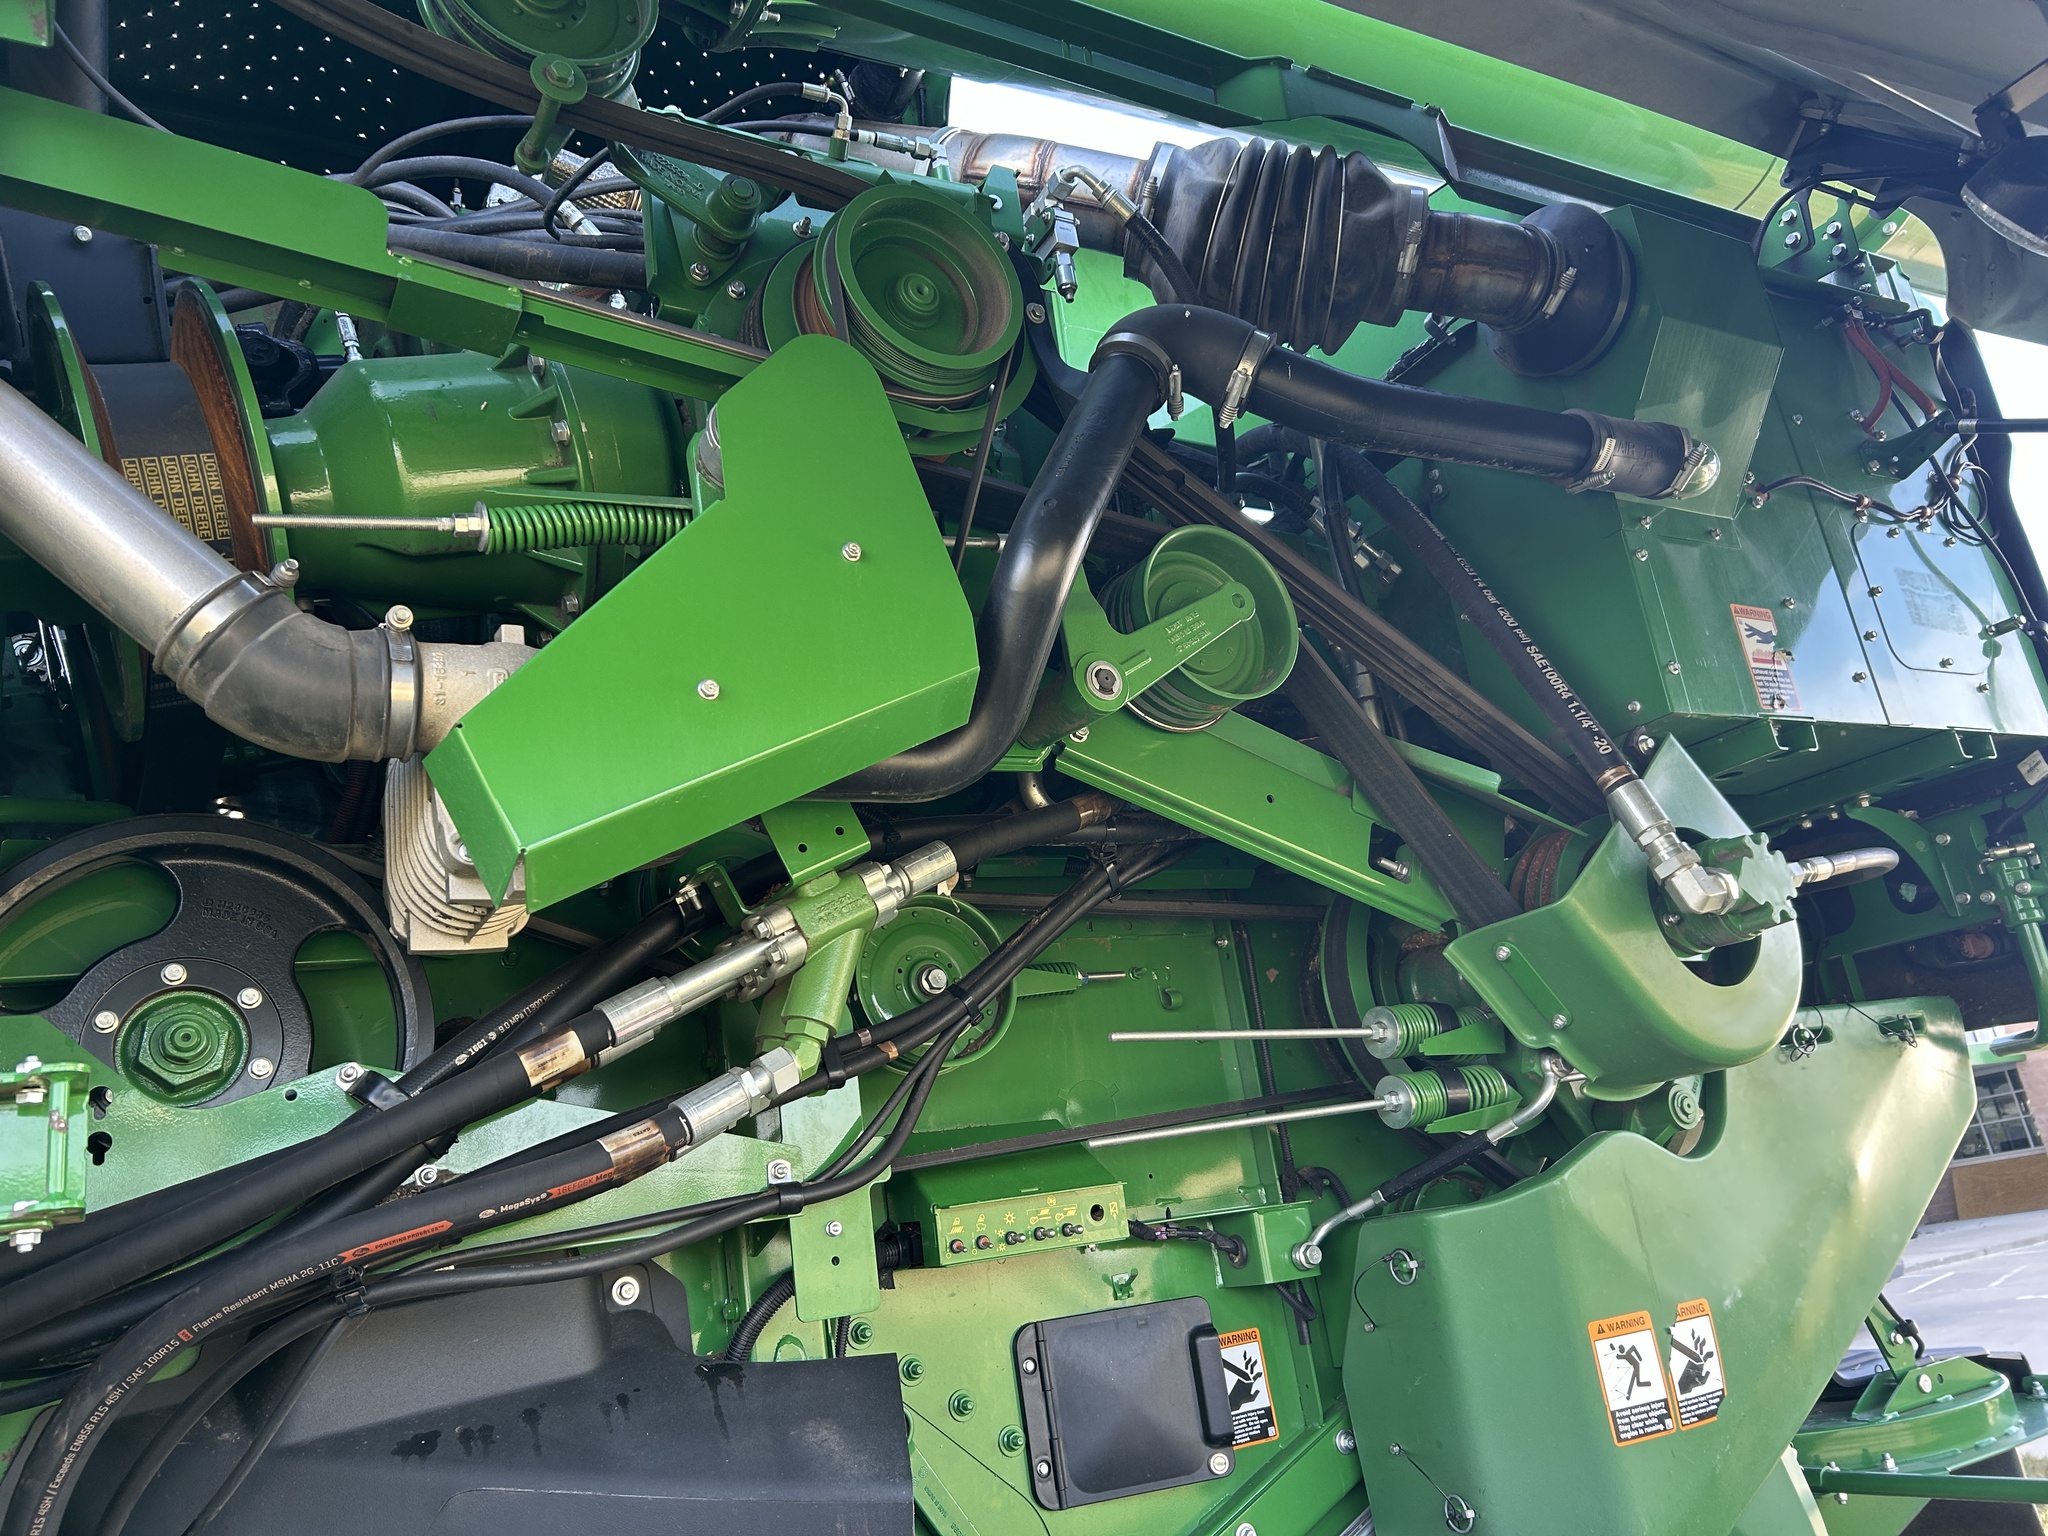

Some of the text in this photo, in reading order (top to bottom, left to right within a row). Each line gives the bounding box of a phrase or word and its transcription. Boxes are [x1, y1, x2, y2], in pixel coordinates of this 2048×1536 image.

[1617, 440, 1636, 456] AIR
[124, 461, 141, 490] JOH
[144, 460, 162, 494] JOHN
[164, 458, 182, 493] JOHN
[183, 456, 211, 540] JOHN DEERE
[202, 455, 221, 490] JOHN
[212, 494, 231, 537] DEERE
[1738, 607, 1772, 619] WARNING
[1482, 588, 1501, 605] bar
[1497, 605, 1519, 627] (200
[1512, 628, 1532, 644] psi)
[1526, 645, 1574, 700] SAE100R4
[1593, 735, 1613, 755] -20
[202, 907, 278, 940] MADE IN USA
[498, 1022, 511, 1033] 9.0
[510, 1013, 524, 1026] MPa
[632, 1127, 651, 1138] GATES
[375, 1235, 407, 1250] POWERING
[1675, 1303, 1706, 1318] ARNING
[1606, 1316, 1646, 1333] WARNING
[1218, 1330, 1258, 1347] WARNING
[30, 1514, 46, 1536] R15
[38, 1496, 54, 1516] 4SH
[49, 1453, 76, 1489] Exceeds
[69, 1423, 95, 1452] EN856
[89, 1405, 109, 1424] R15
[104, 1387, 125, 1406] 4SH
[126, 1367, 146, 1384] SAE
[143, 1338, 180, 1369] 100R15
[192, 1311, 223, 1333] Flame
[222, 1287, 270, 1315] Resistant
[269, 1273, 300, 1291] MSHA
[300, 1258, 339, 1278] 2G-11C
[1616, 1401, 1665, 1418] Avoid serious injury
[1616, 1408, 1668, 1425] from thrown objects.
[1618, 1417, 1658, 1432] Stay clear while
[1620, 1423, 1665, 1439] engine is running.
